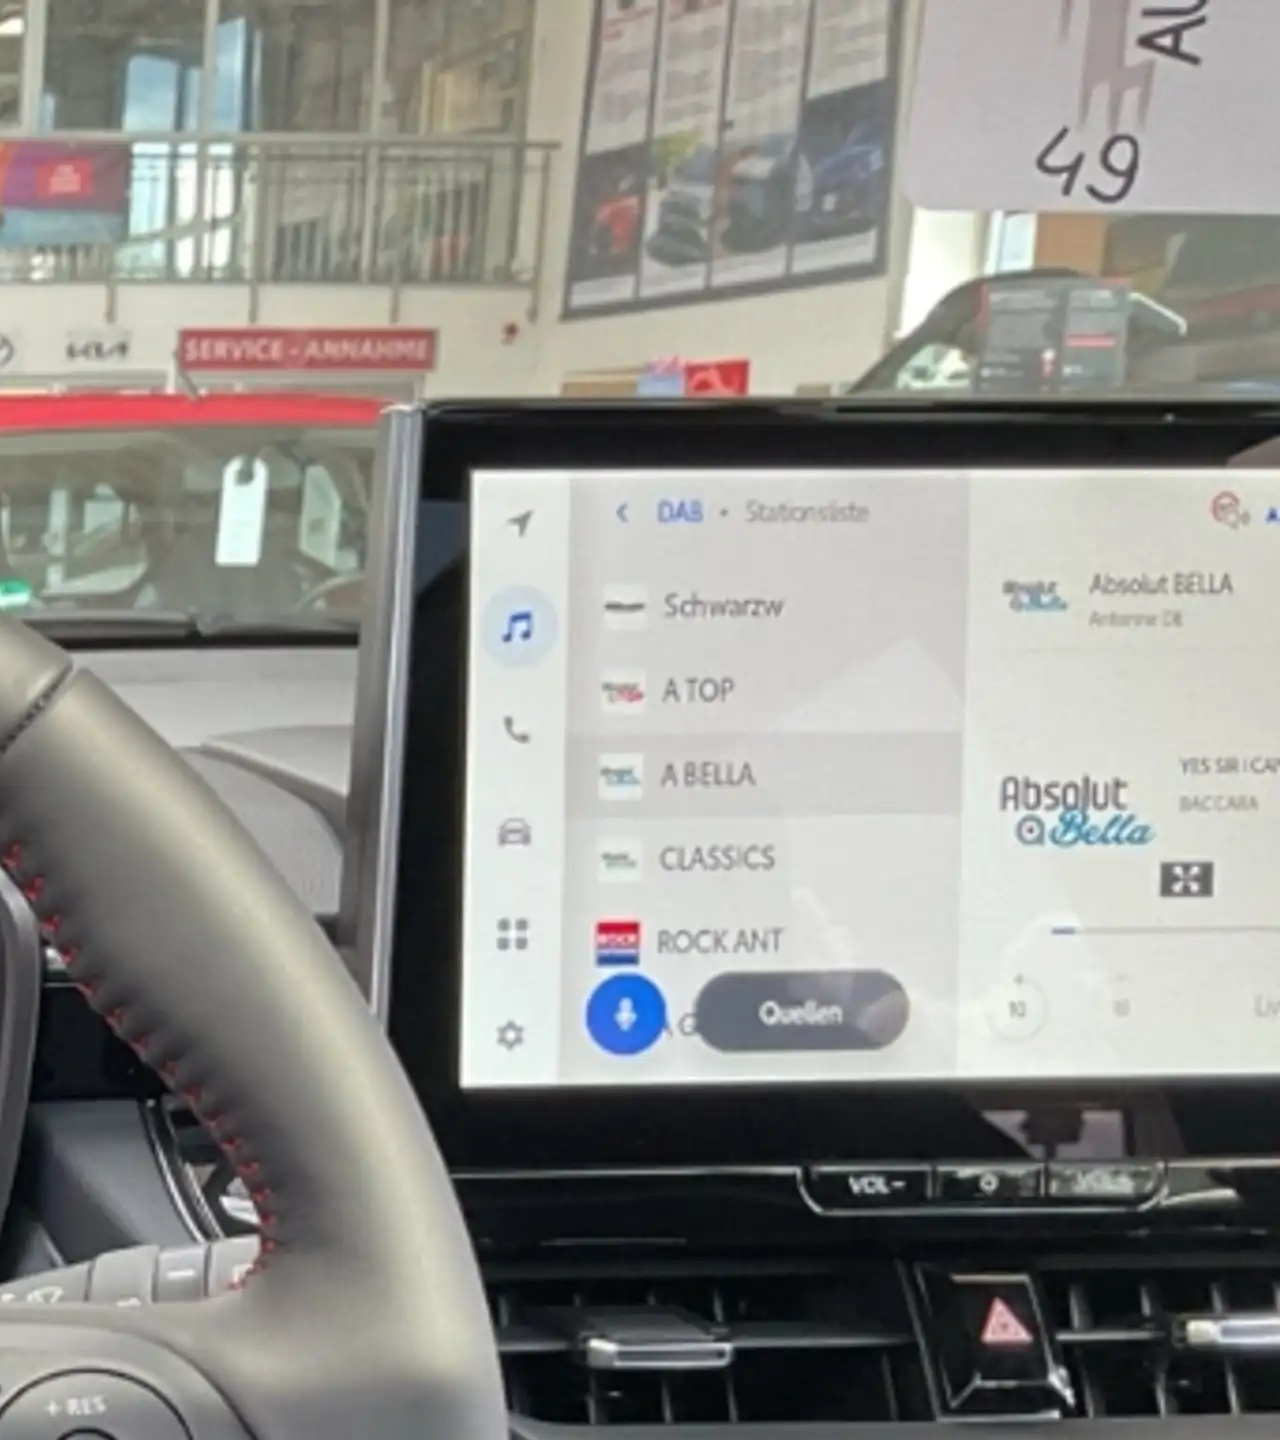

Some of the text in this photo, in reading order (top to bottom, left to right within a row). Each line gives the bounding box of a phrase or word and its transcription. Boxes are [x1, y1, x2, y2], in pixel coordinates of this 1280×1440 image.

[1035, 125, 1141, 204] 49
[184, 337, 279, 361] SERVICE
[657, 499, 870, 524] DAB Stationsliste
[1090, 572, 1233, 595] Absolut BELLA
[664, 592, 785, 618] Schwarzw
[662, 678, 679, 702] A
[684, 678, 735, 702] TOP
[660, 763, 678, 788] A
[684, 762, 757, 788] BELLA
[1179, 756, 1210, 775] YES
[1000, 774, 1129, 812] Absolut
[1049, 808, 1157, 848] Bella
[659, 845, 776, 871] CLASSICS
[657, 928, 784, 954] ROCK ANT
[758, 1000, 843, 1027] Quellen
